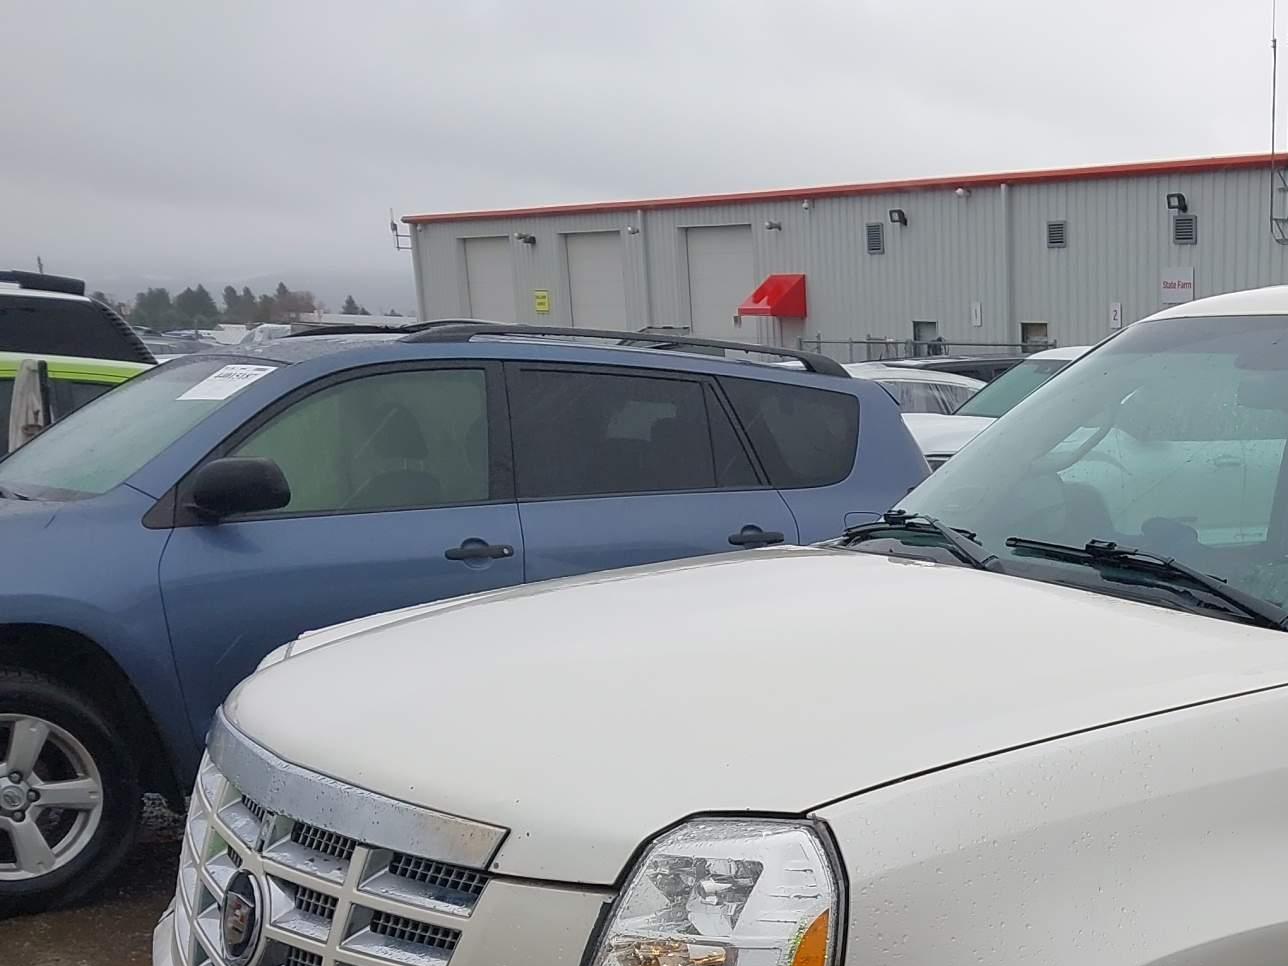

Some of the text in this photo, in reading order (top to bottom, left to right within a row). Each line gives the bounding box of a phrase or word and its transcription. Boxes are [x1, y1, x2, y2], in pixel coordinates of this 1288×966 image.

[1162, 280, 1192, 289] State Farm
[1112, 309, 1119, 321] 2
